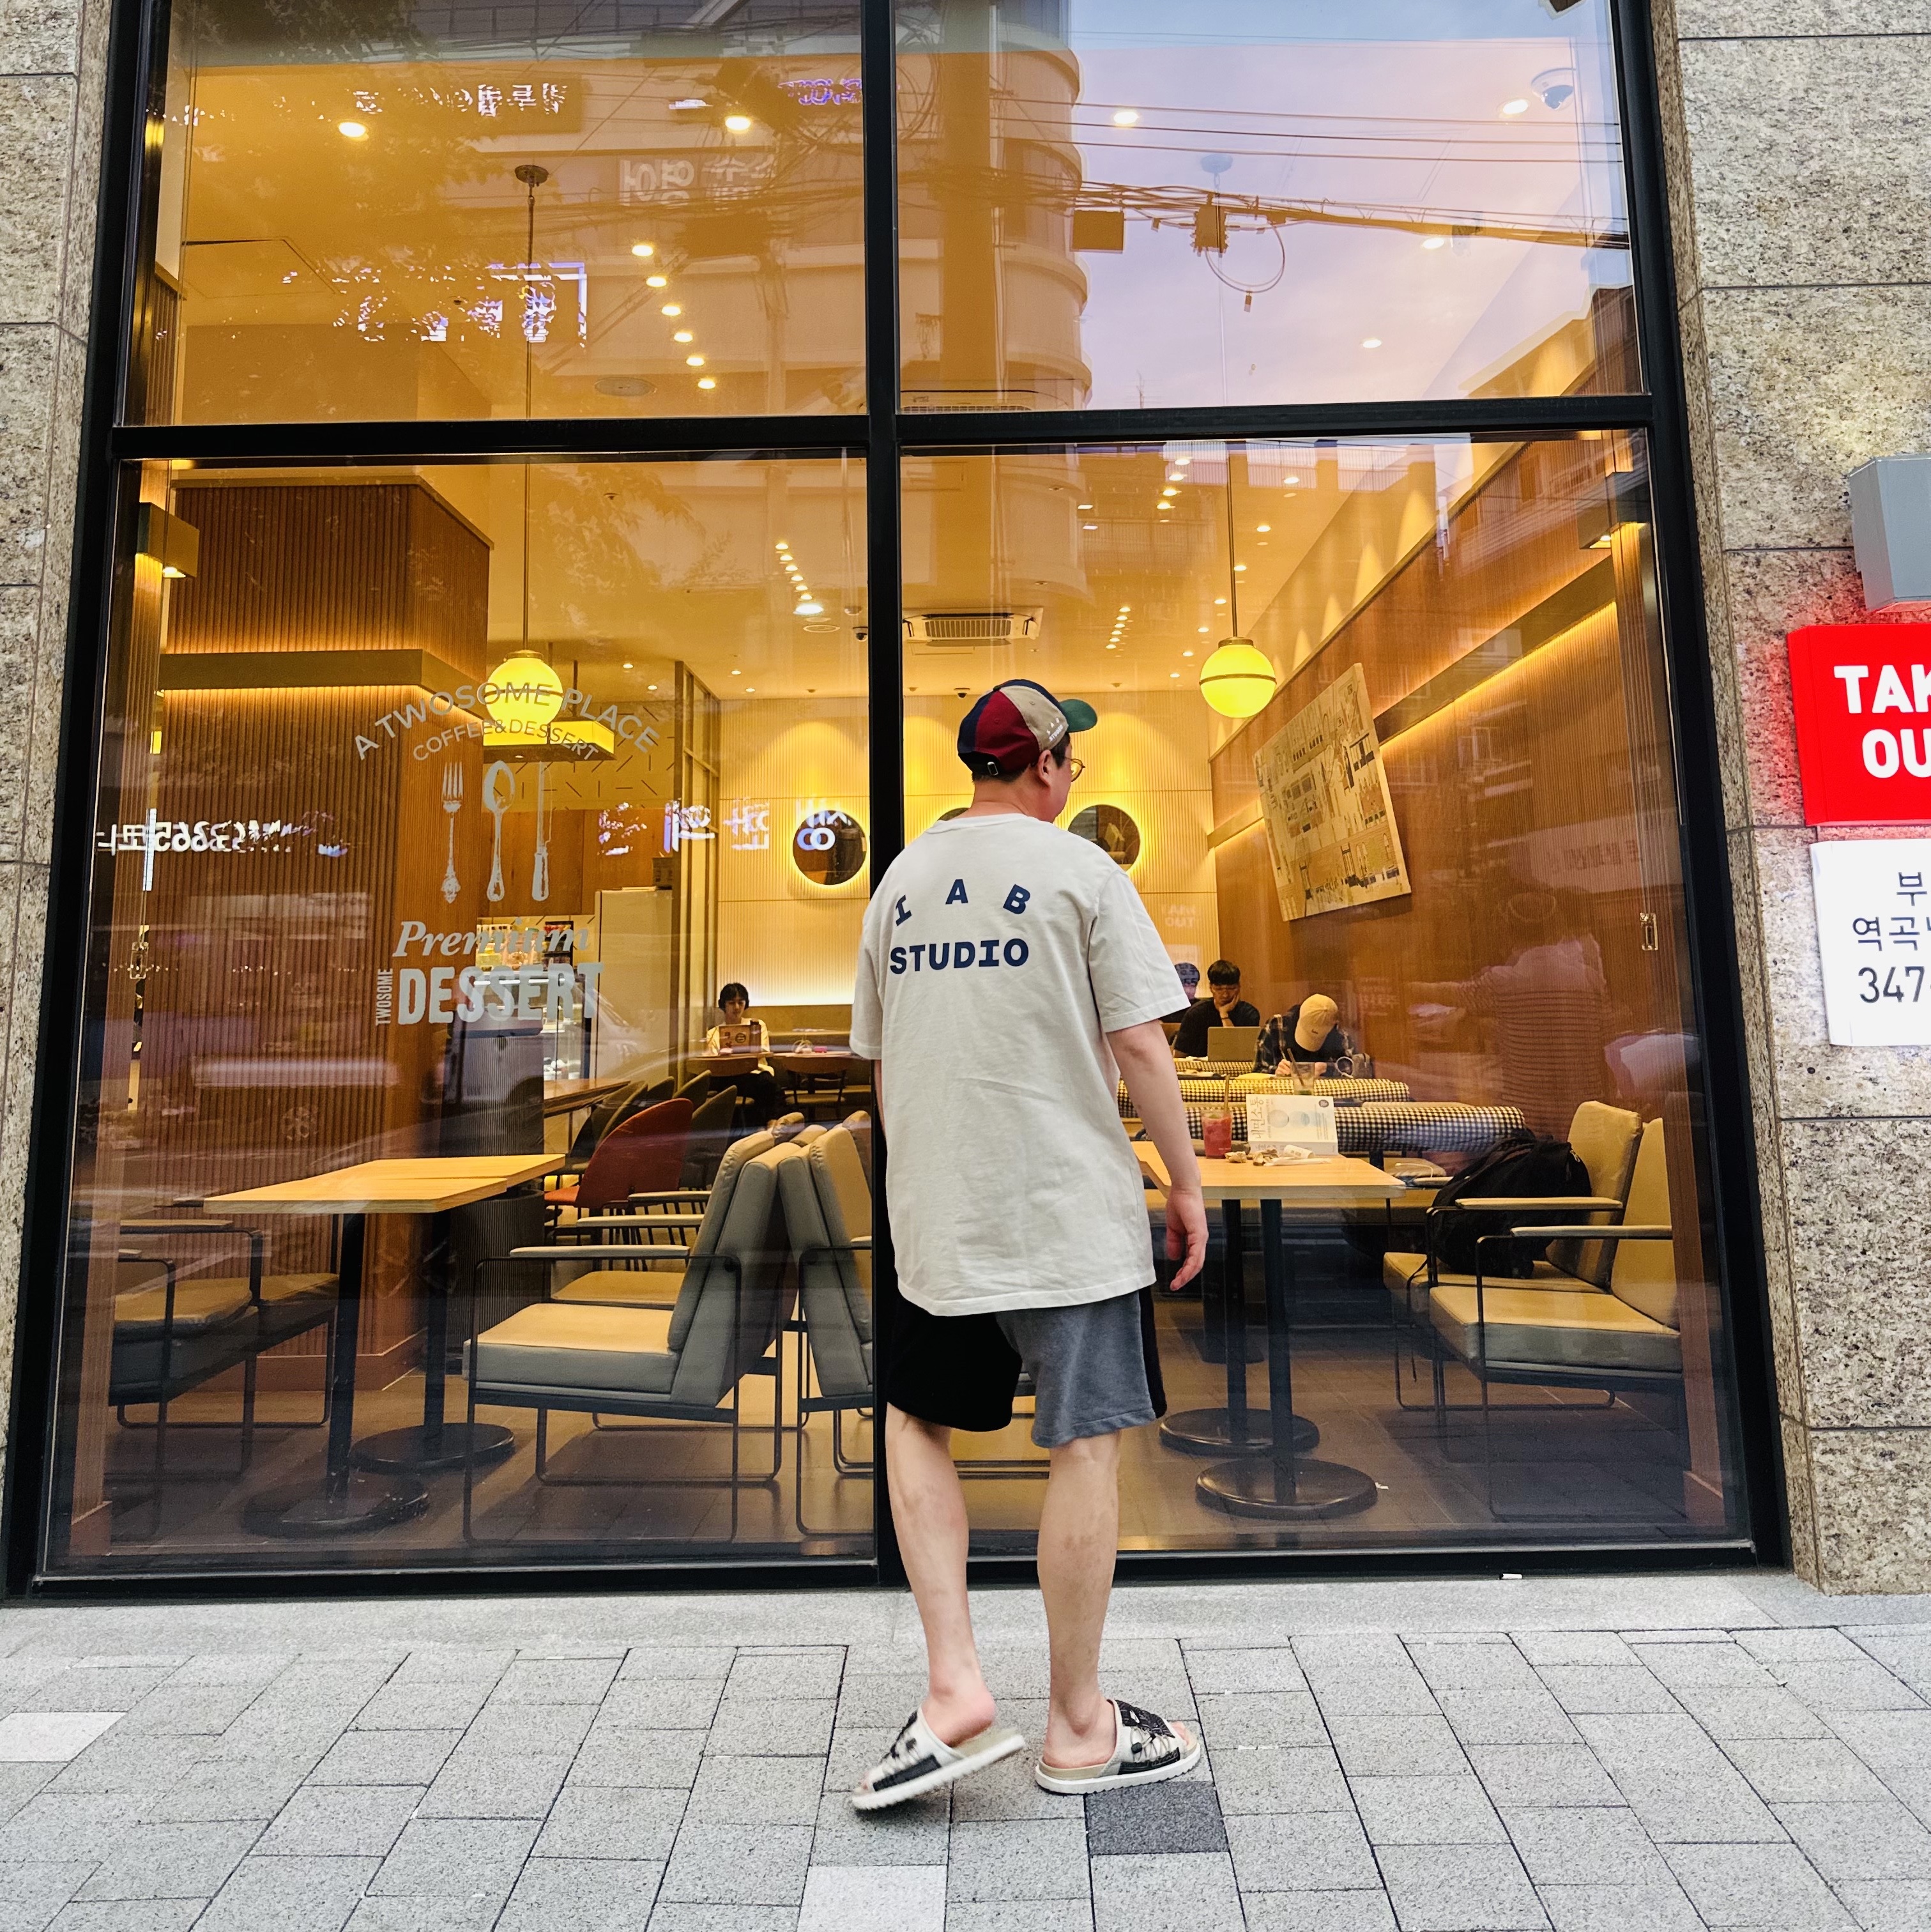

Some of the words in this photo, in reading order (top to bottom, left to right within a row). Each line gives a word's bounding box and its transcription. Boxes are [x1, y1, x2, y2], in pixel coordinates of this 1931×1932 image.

[352, 735, 379, 760] A
[374, 681, 554, 739] TWOSOME
[560, 687, 661, 754] PLACE
[413, 718, 599, 762] COFFEE&DESSERT
[1896, 871, 1928, 907] 부
[392, 917, 589, 958] Premium
[1852, 916, 1931, 952] 역곡
[889, 938, 1029, 975] STUDIO
[375, 967, 393, 1026] TWOSOME
[397, 961, 604, 1025] DESSERT
[1250, 1096, 1266, 1139] 내면소통
